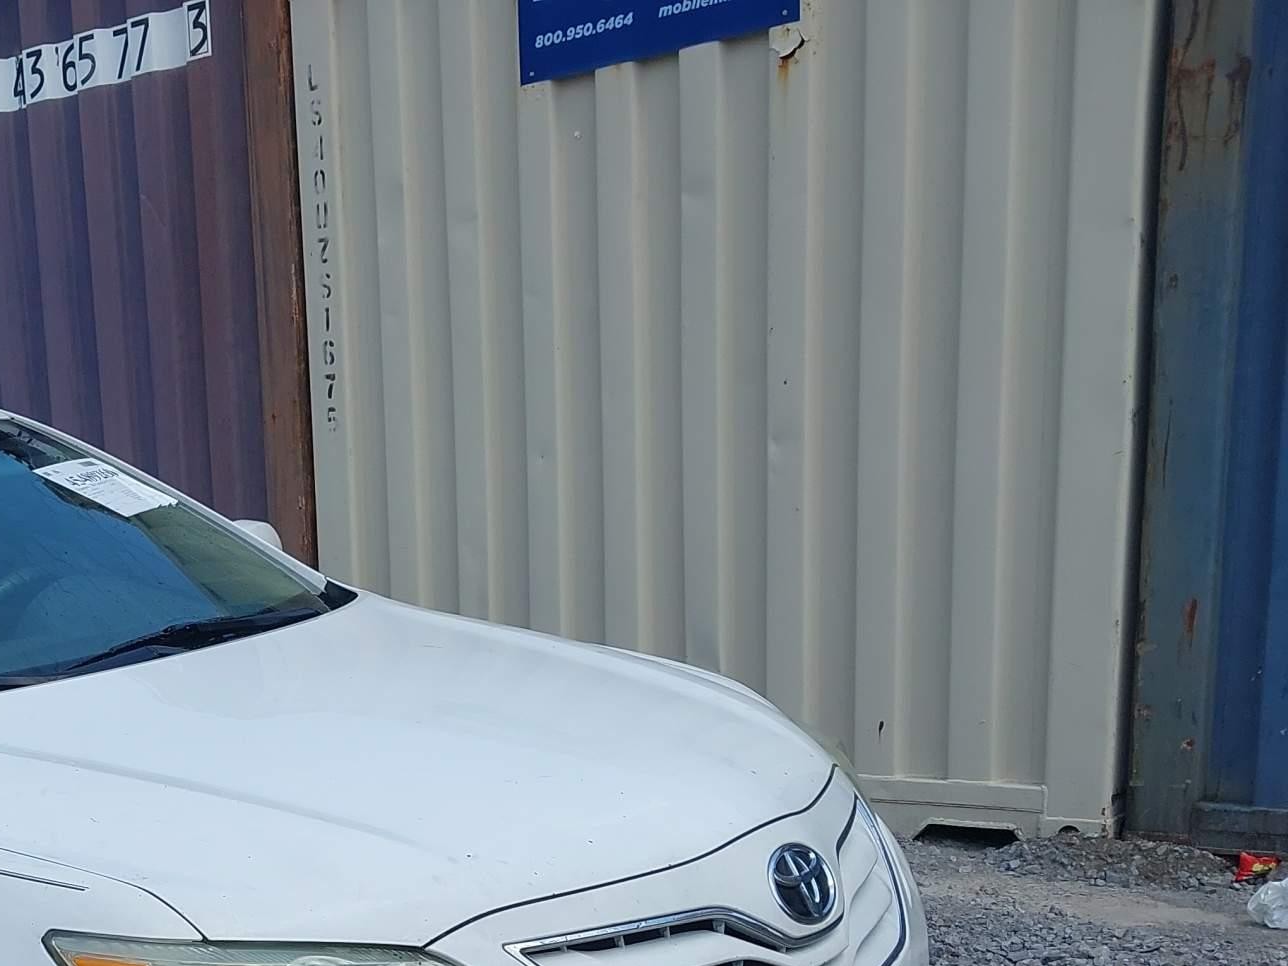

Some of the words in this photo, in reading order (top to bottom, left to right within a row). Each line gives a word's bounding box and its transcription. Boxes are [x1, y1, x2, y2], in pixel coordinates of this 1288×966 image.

[113, 17, 150, 79] 77
[188, 3, 208, 56] 3
[535, 12, 634, 48] 800.950.6464
